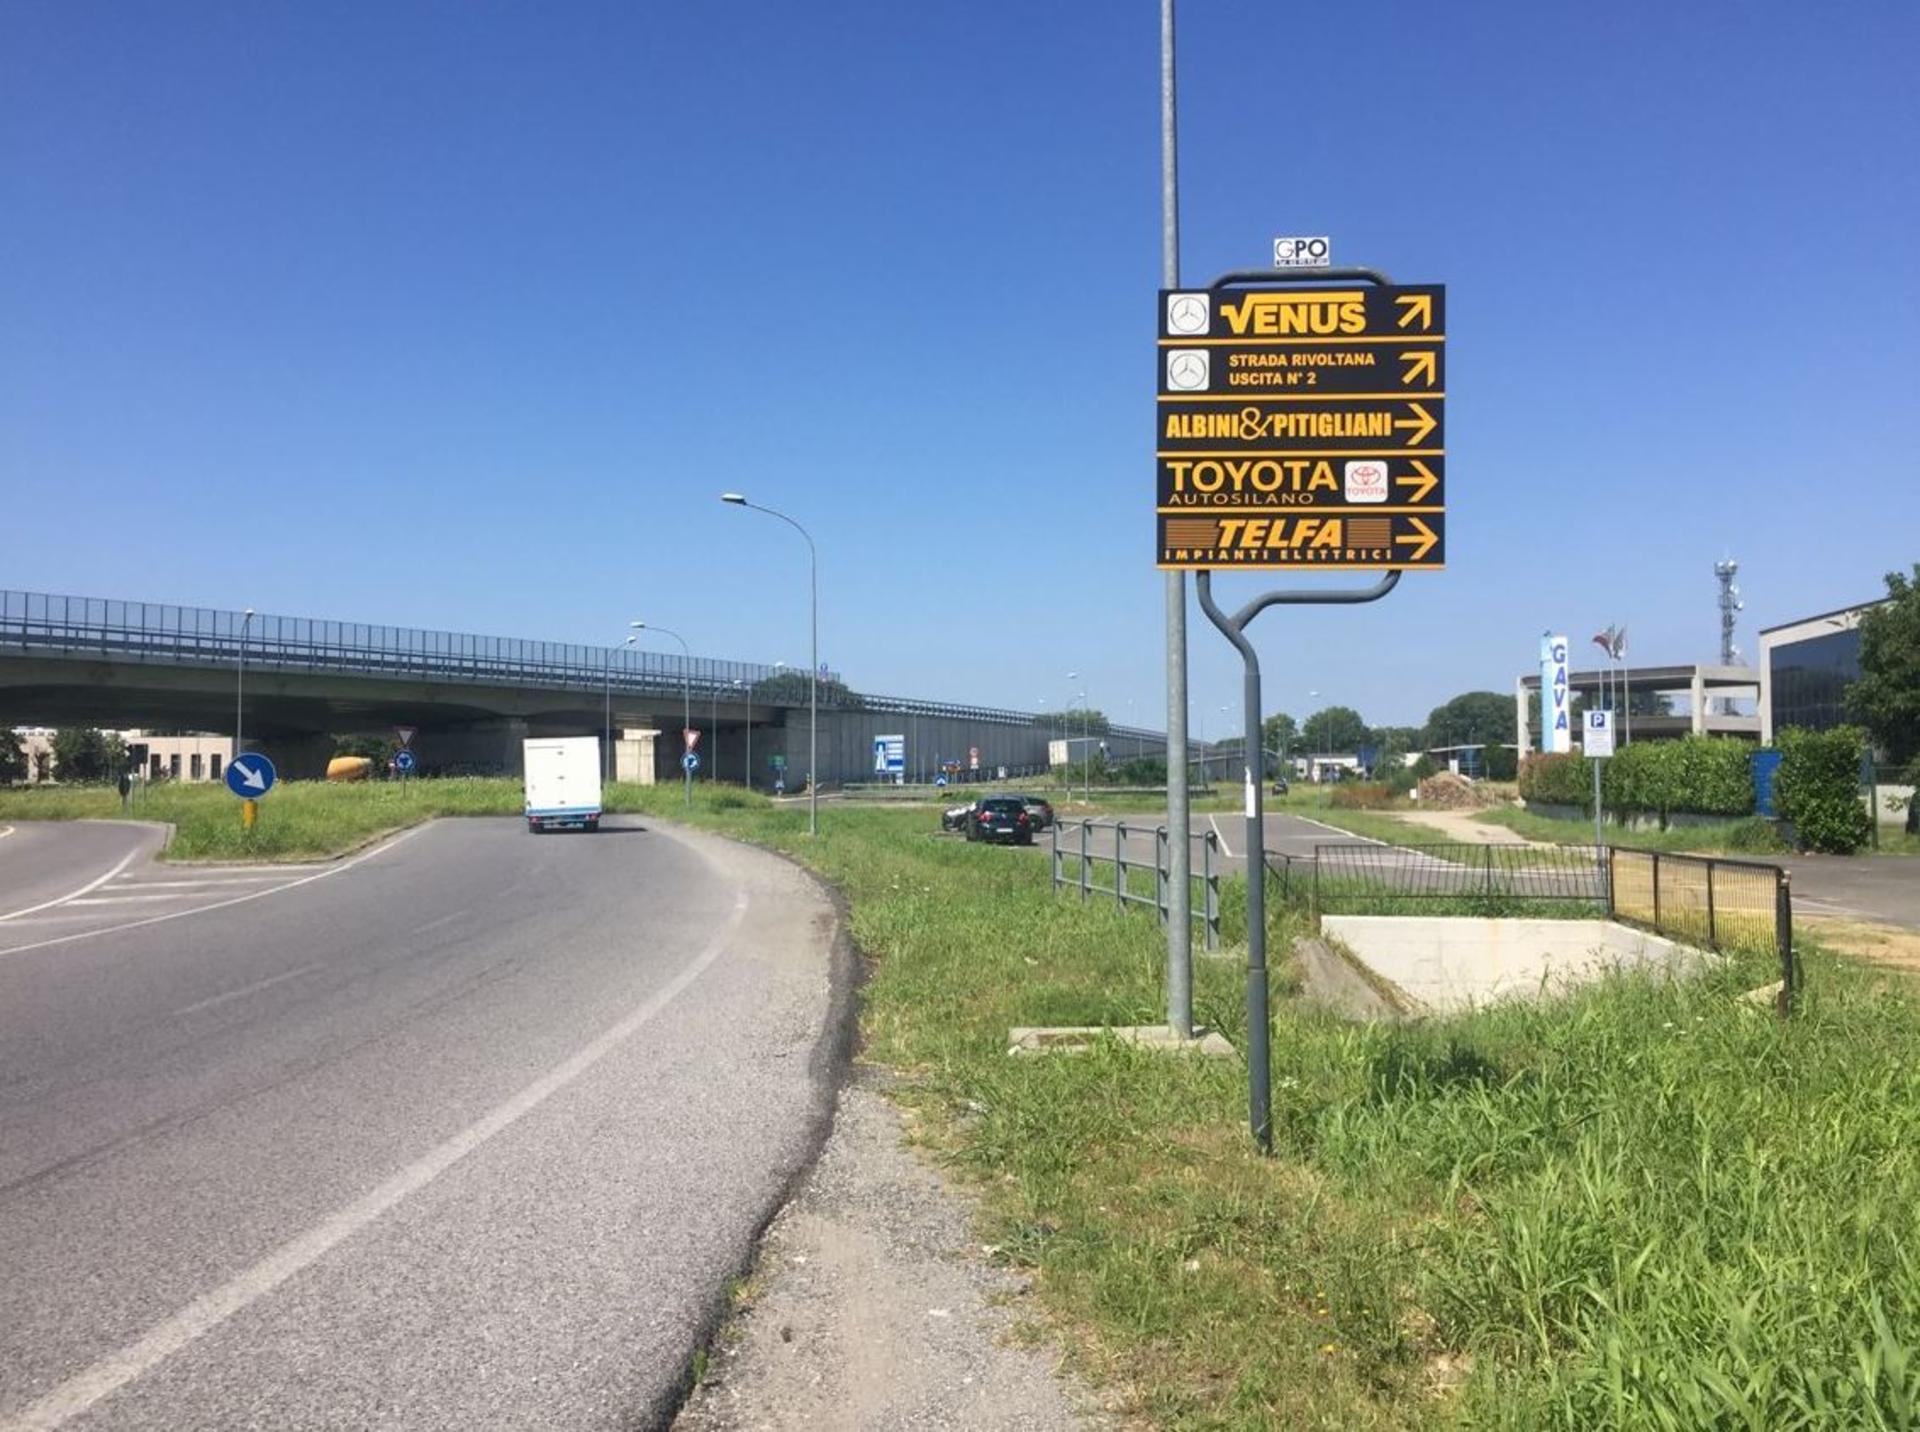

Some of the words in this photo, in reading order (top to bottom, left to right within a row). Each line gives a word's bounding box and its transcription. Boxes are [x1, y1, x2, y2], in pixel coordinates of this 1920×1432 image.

[1276, 239, 1327, 258] GPO
[1221, 292, 1367, 334] VENUS
[1229, 354, 1288, 367] STRADA
[1291, 353, 1375, 366] RIVOLTANA
[1229, 373, 1283, 385] USCITA
[1306, 372, 1317, 385] 2
[1166, 461, 1339, 491] TOYOTA
[1168, 493, 1314, 505] AUTOSILANO
[1217, 519, 1342, 548] TELFA
[1165, 550, 1268, 560] IMPIANTI
[1280, 549, 1392, 560] ELETTRICI
[1552, 644, 1568, 730] GAVA
